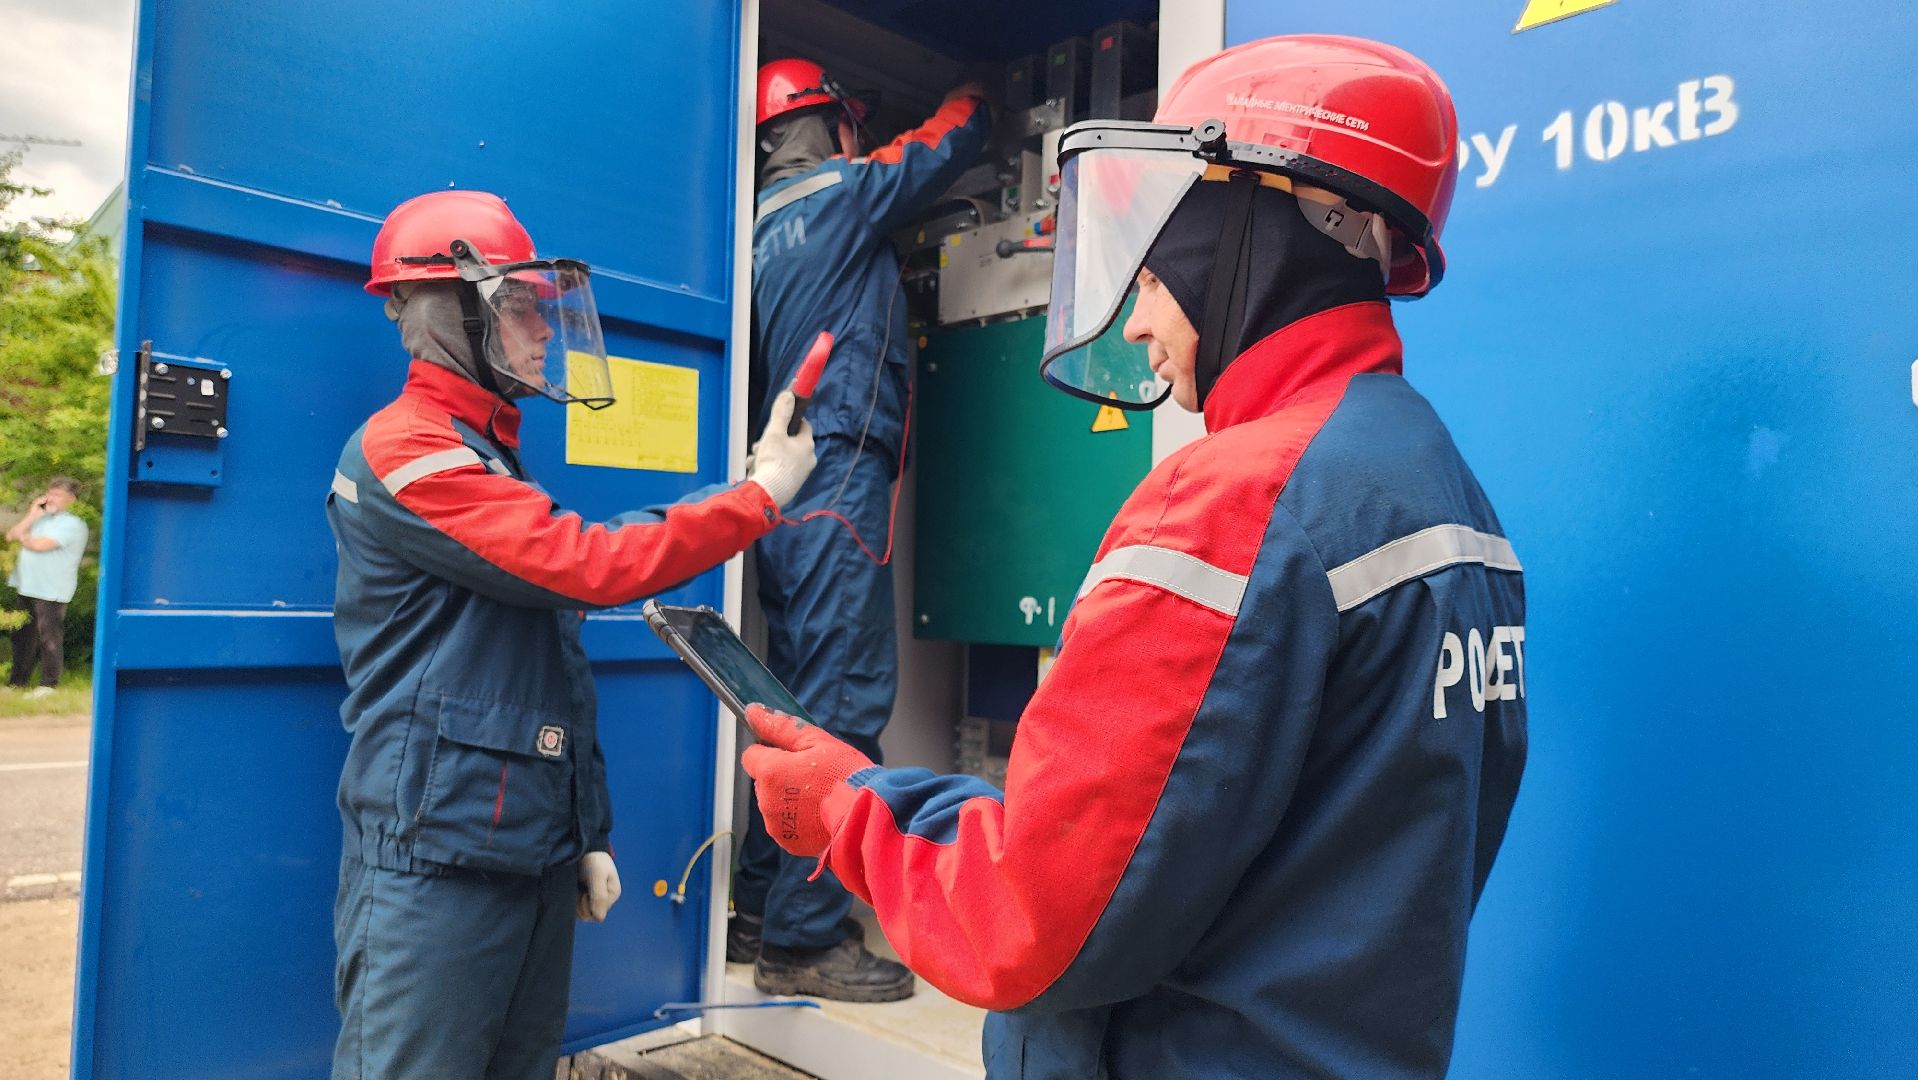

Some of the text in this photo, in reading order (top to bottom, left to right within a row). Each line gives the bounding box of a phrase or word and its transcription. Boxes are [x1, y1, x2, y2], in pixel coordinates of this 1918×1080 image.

[1345, 116, 1370, 131] СЕТИ
[1542, 73, 1740, 172] 10кВ
[752, 214, 807, 268] ЕТИ
